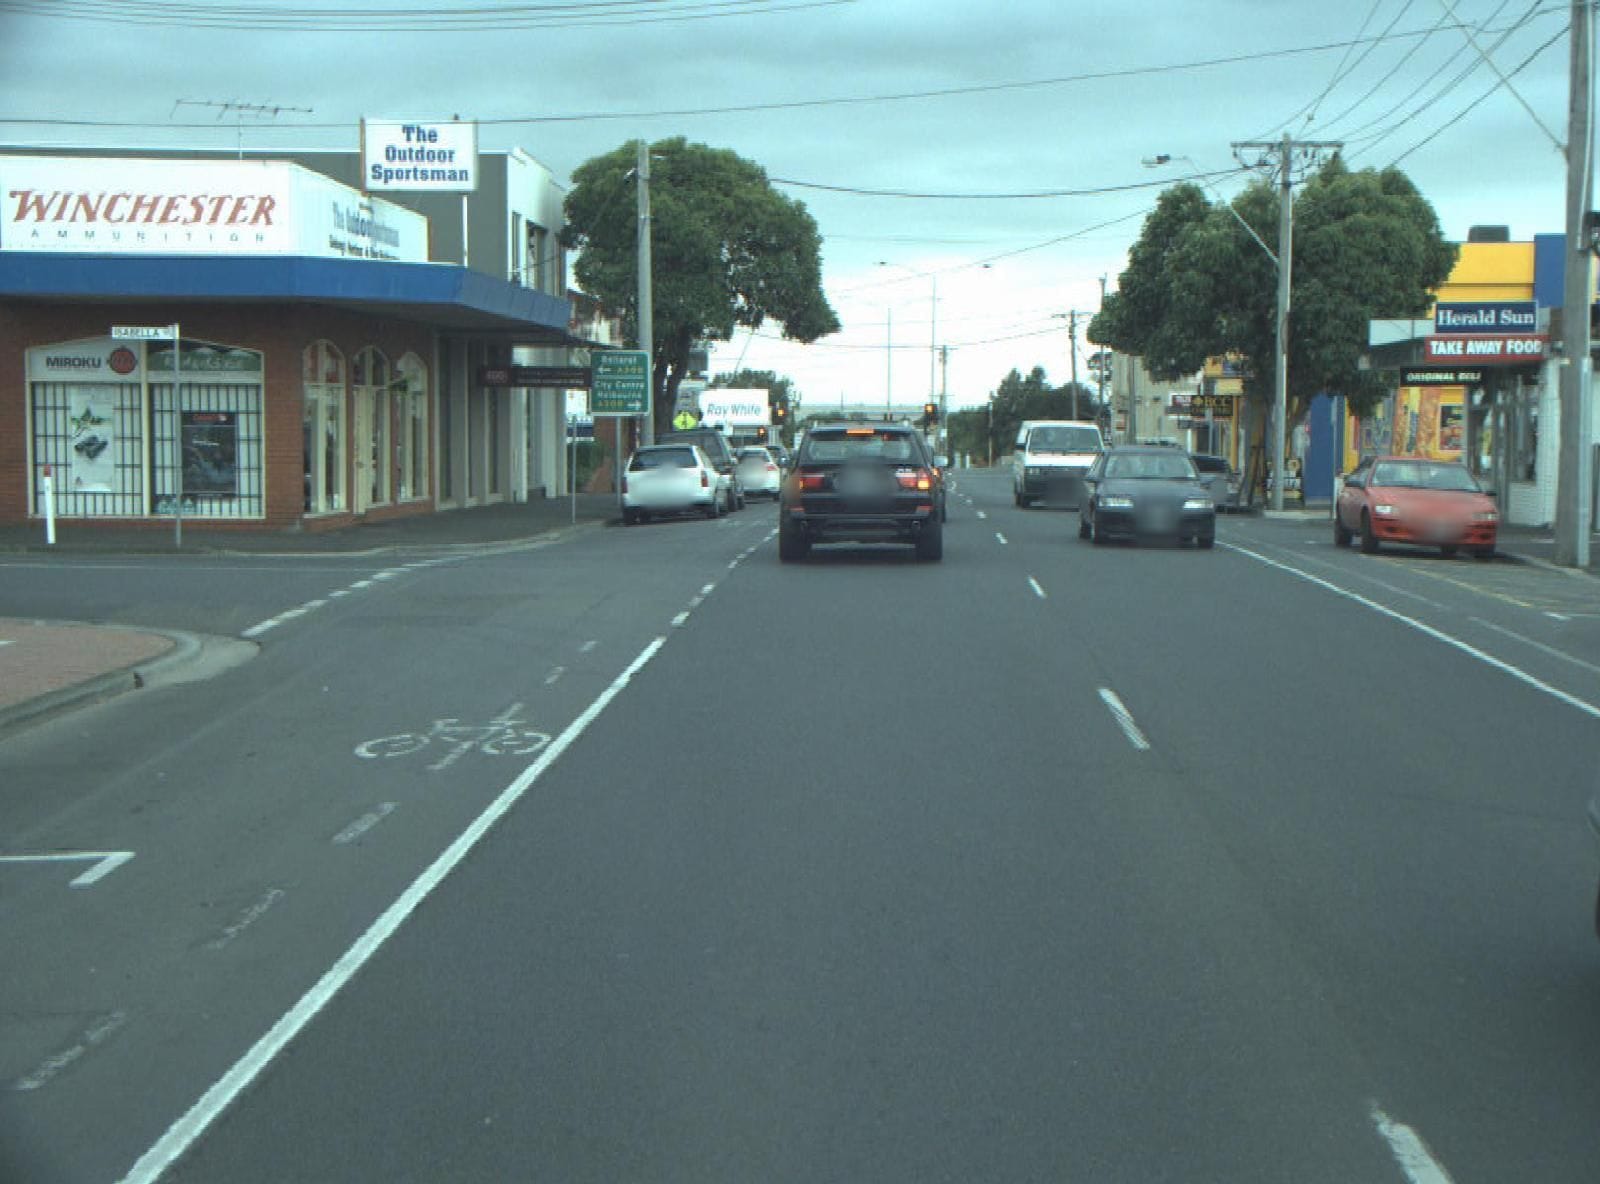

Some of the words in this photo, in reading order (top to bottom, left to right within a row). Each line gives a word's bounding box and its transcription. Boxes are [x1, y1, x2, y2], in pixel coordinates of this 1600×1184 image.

[402, 124, 438, 143] The
[385, 145, 455, 163] Outdoor
[371, 163, 469, 185] Sportsman
[9, 190, 277, 225] WINCHESTER
[1438, 309, 1496, 326] Herald
[1500, 309, 1535, 326] Sun
[1430, 340, 1464, 355] TAKE
[1466, 340, 1504, 355] AWAY
[1506, 339, 1543, 354] FOOD
[46, 355, 102, 368] MIROKU
[706, 402, 728, 419] Ray
[730, 402, 762, 417] White
